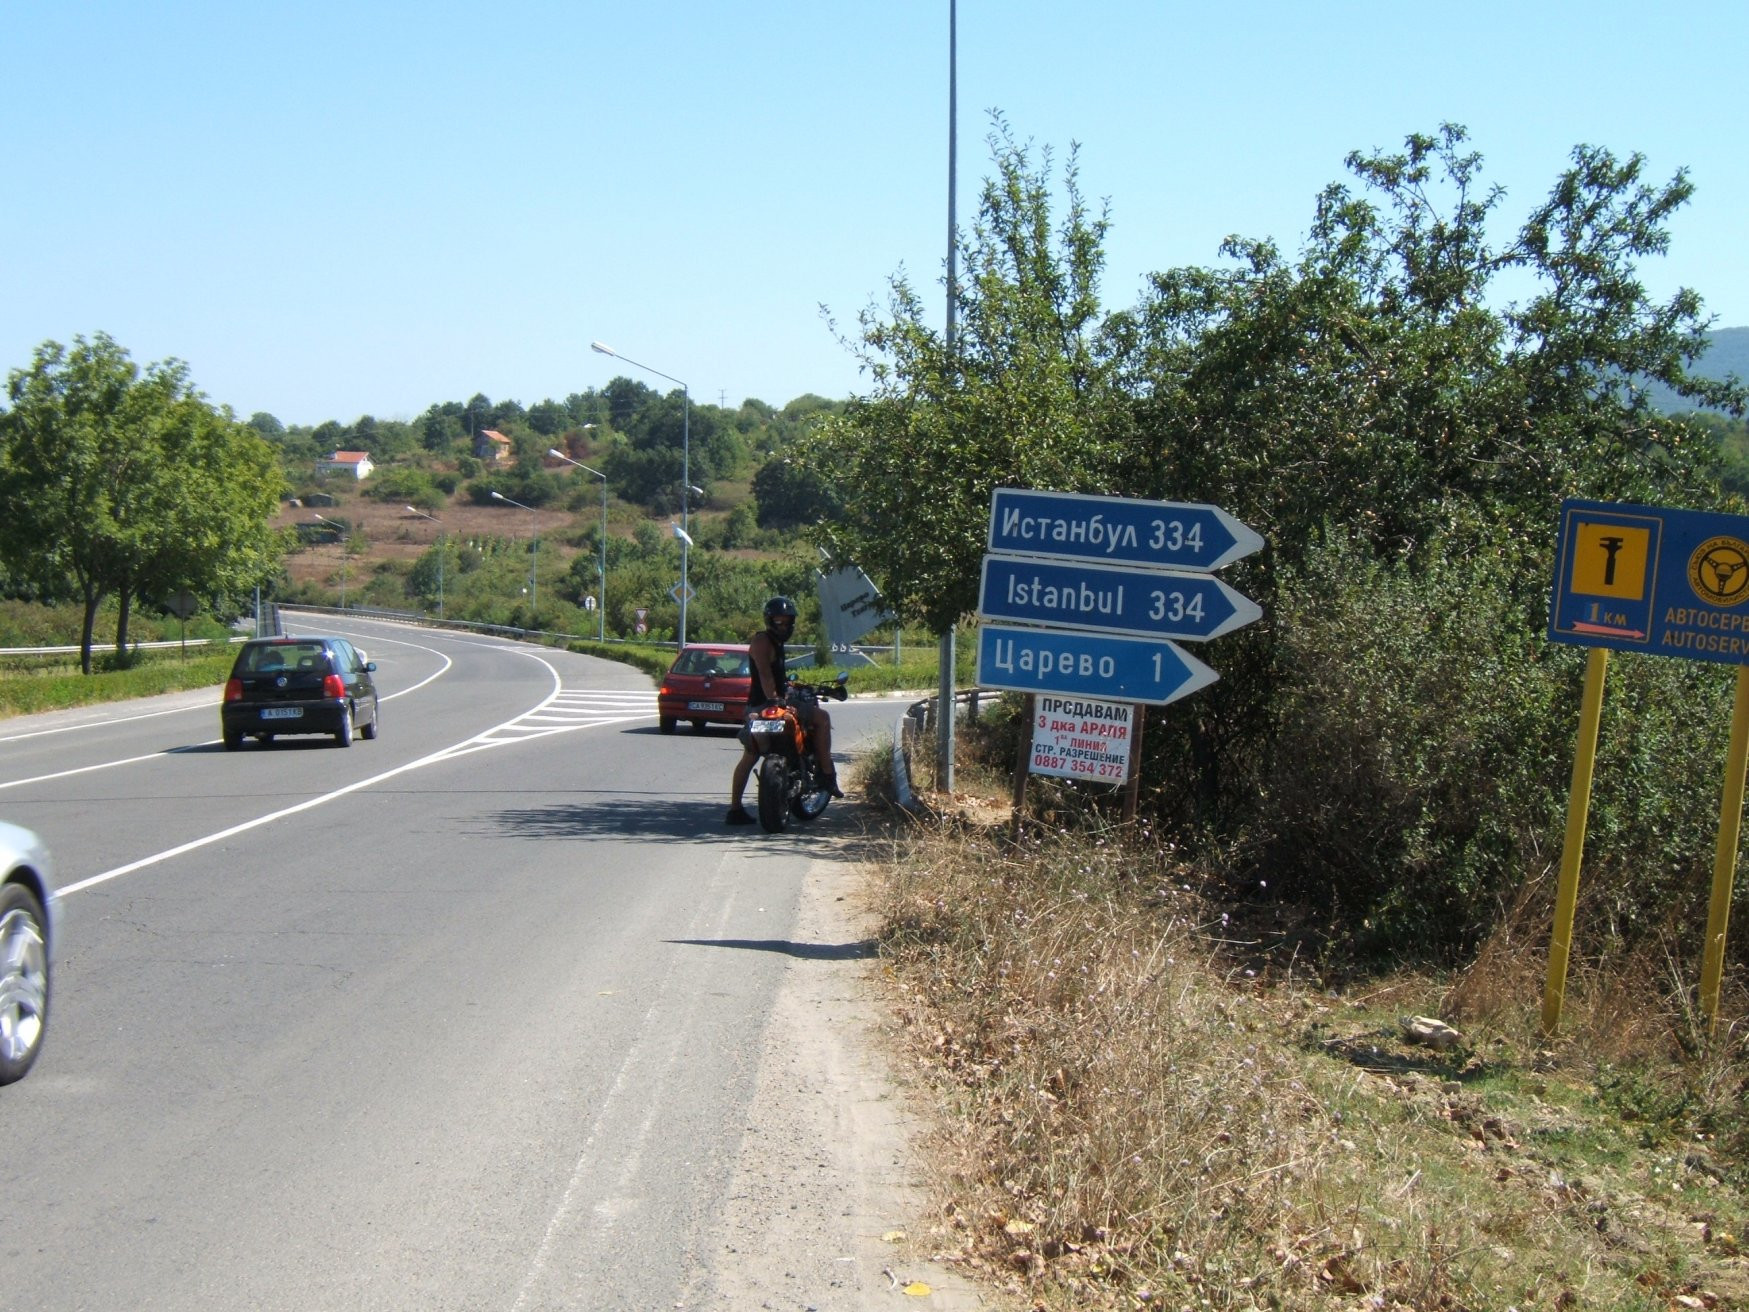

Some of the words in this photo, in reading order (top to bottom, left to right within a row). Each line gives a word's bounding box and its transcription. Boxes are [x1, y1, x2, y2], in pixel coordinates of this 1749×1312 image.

[1002, 507, 1138, 553] Истанбул
[1149, 519, 1204, 553] 334
[1008, 574, 1123, 615] Istanbul
[1149, 591, 1205, 623] 334
[1590, 603, 1600, 622] 1
[995, 639, 1115, 679] Царево
[1152, 653, 1162, 682] 1
[1042, 698, 1128, 722] ПРОДАВАМ
[1038, 715, 1046, 729] 3
[1050, 720, 1075, 733] дка
[1034, 754, 1067, 769] 0887
[1070, 759, 1095, 774] 354
[1098, 763, 1122, 778] 372
[1035, 744, 1056, 756] СТР.
[1060, 747, 1125, 765] РАЗРЕШЕНИЕ
